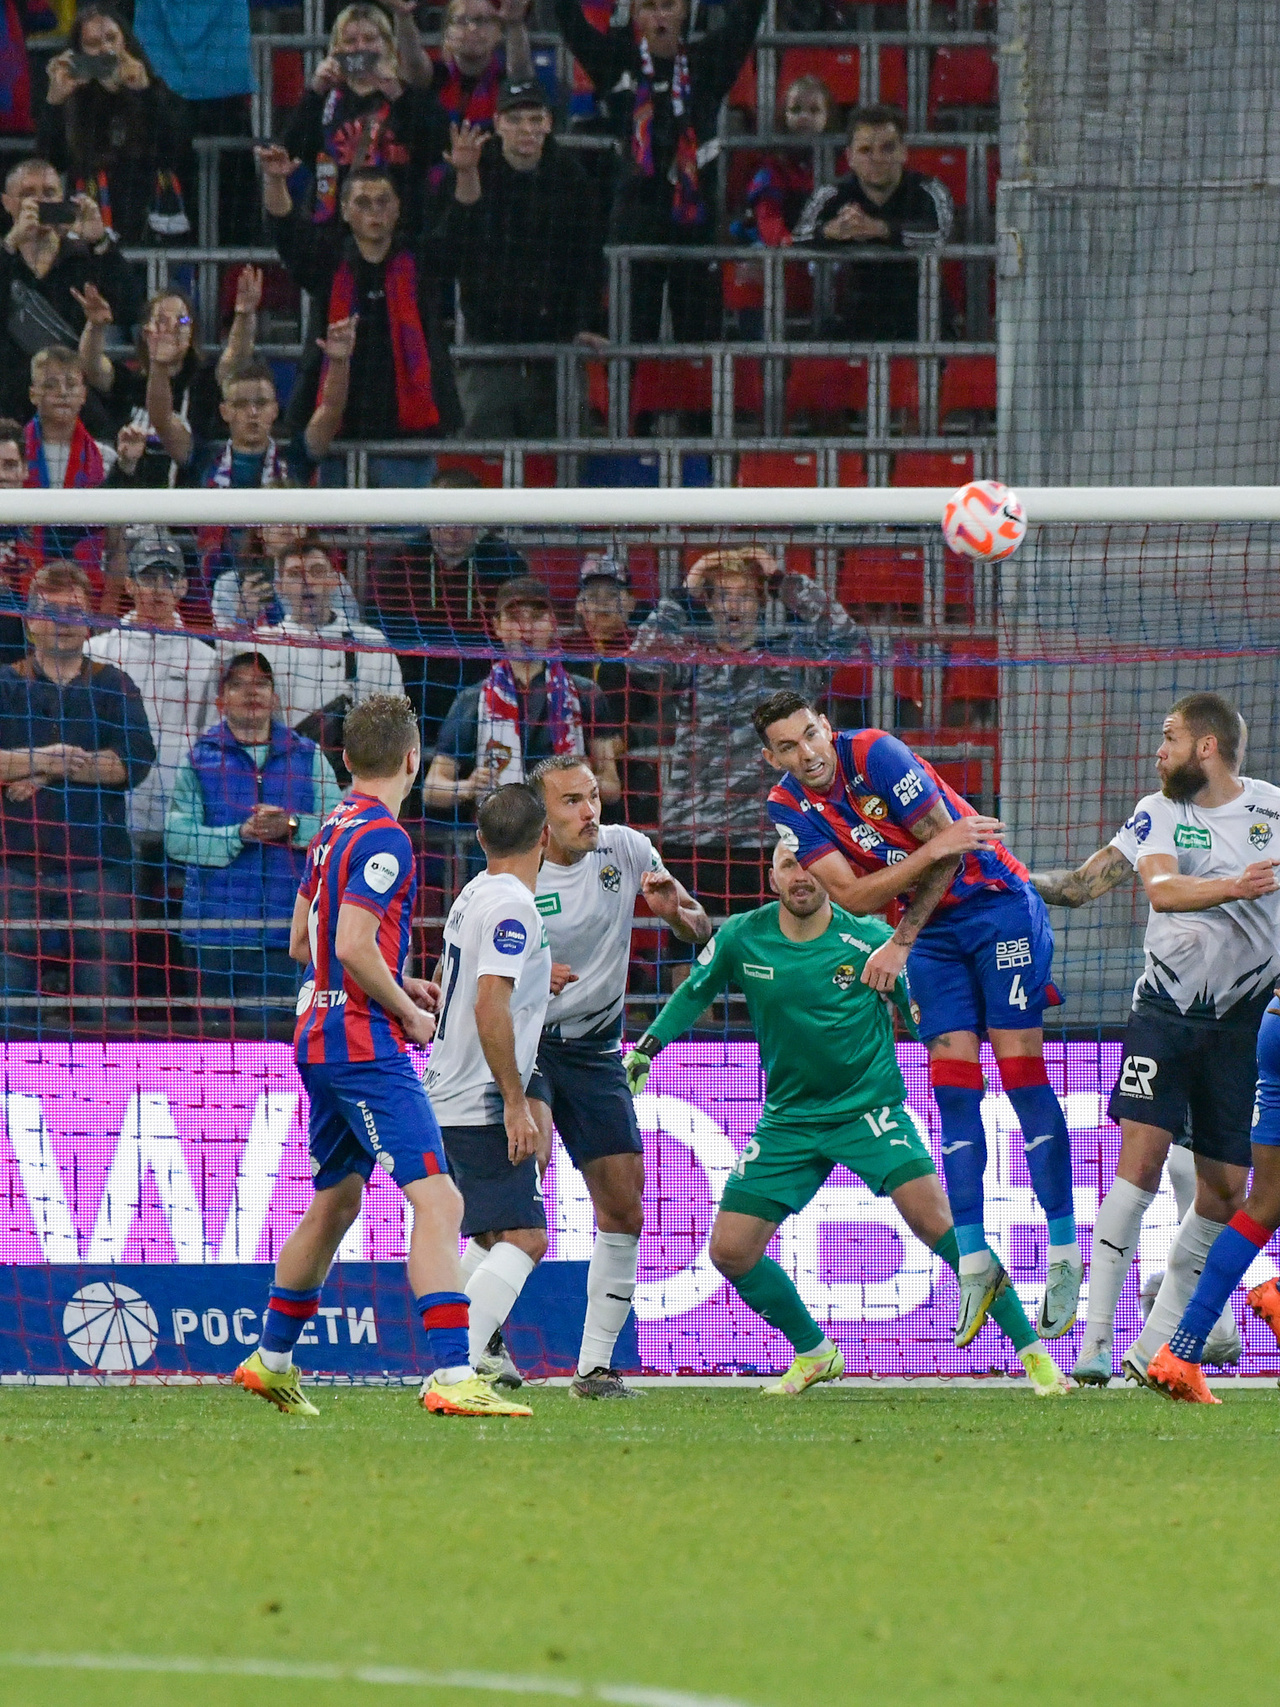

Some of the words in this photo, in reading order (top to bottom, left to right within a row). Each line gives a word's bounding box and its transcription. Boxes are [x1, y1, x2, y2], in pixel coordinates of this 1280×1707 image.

[892, 769, 917, 797] FON
[900, 778, 923, 807] BET
[859, 832, 884, 852] BET
[1008, 974, 1028, 1011] 4
[860, 1106, 899, 1138] 12
